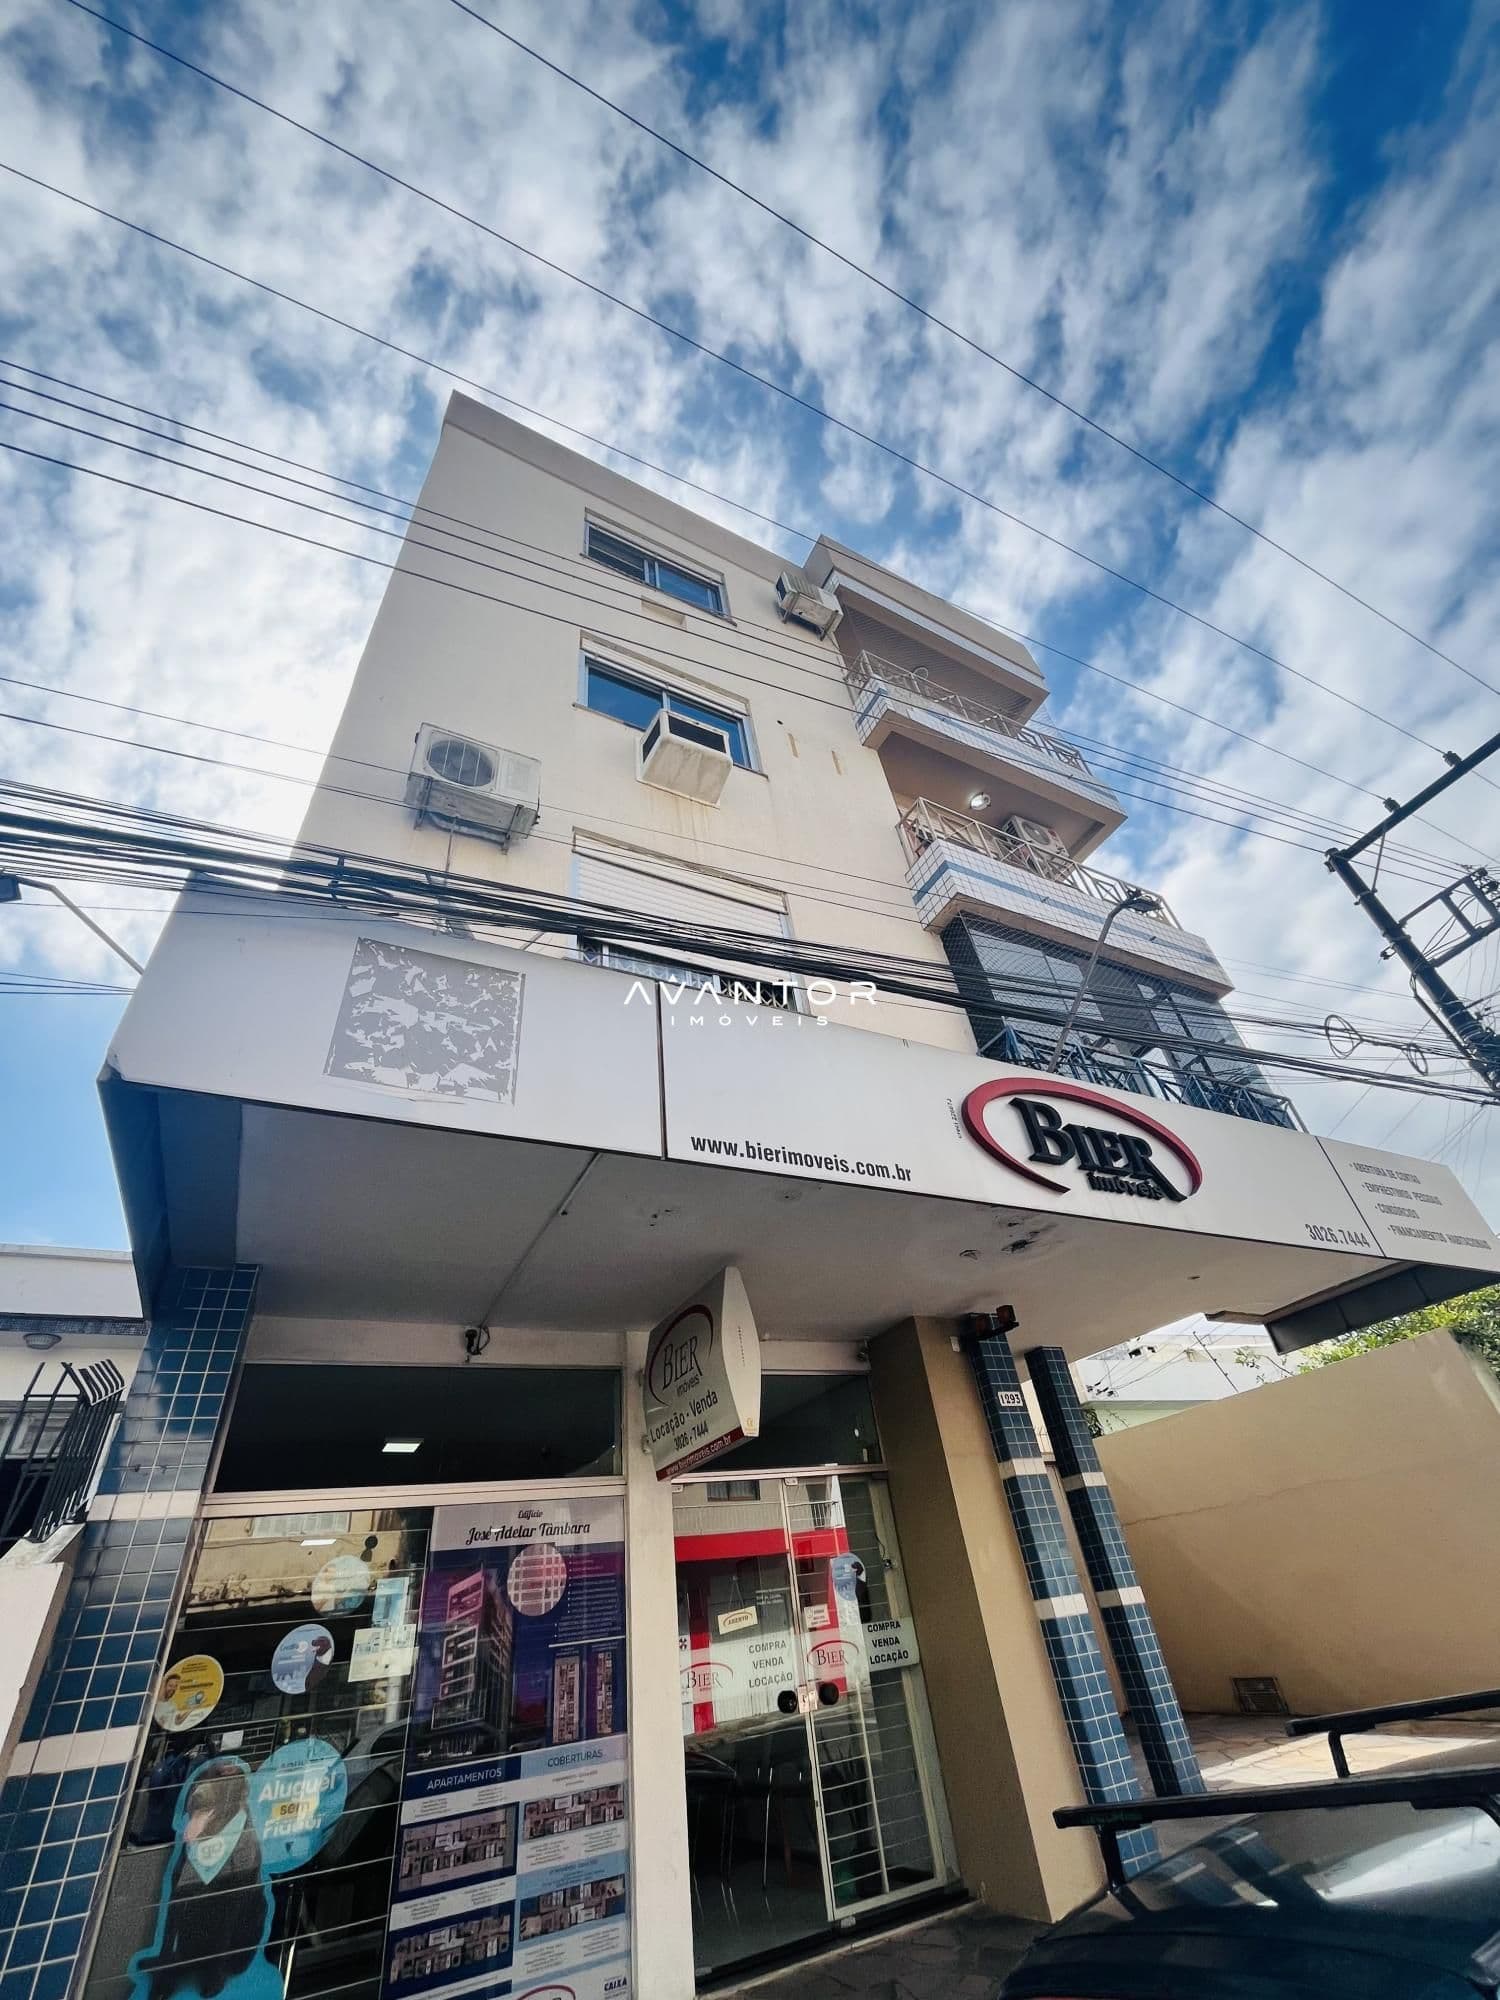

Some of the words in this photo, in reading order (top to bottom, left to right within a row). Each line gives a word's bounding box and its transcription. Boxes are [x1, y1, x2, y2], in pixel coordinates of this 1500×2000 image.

[691, 1136, 912, 1182] www.bierimoveis.com.br
[1305, 1223, 1371, 1248] 3026.7444
[1001, 1393, 1021, 1404] 1293
[650, 1412, 686, 1443] Locação
[689, 1389, 718, 1416] Venda
[868, 1621, 901, 1633] COMPRA
[748, 1640, 787, 1654] COMPRA
[872, 1636, 900, 1648] VENDA
[752, 1656, 784, 1669] VENDA
[547, 1749, 604, 1767] COBERTURAS
[426, 1768, 502, 1790] APARTAMENTOS
